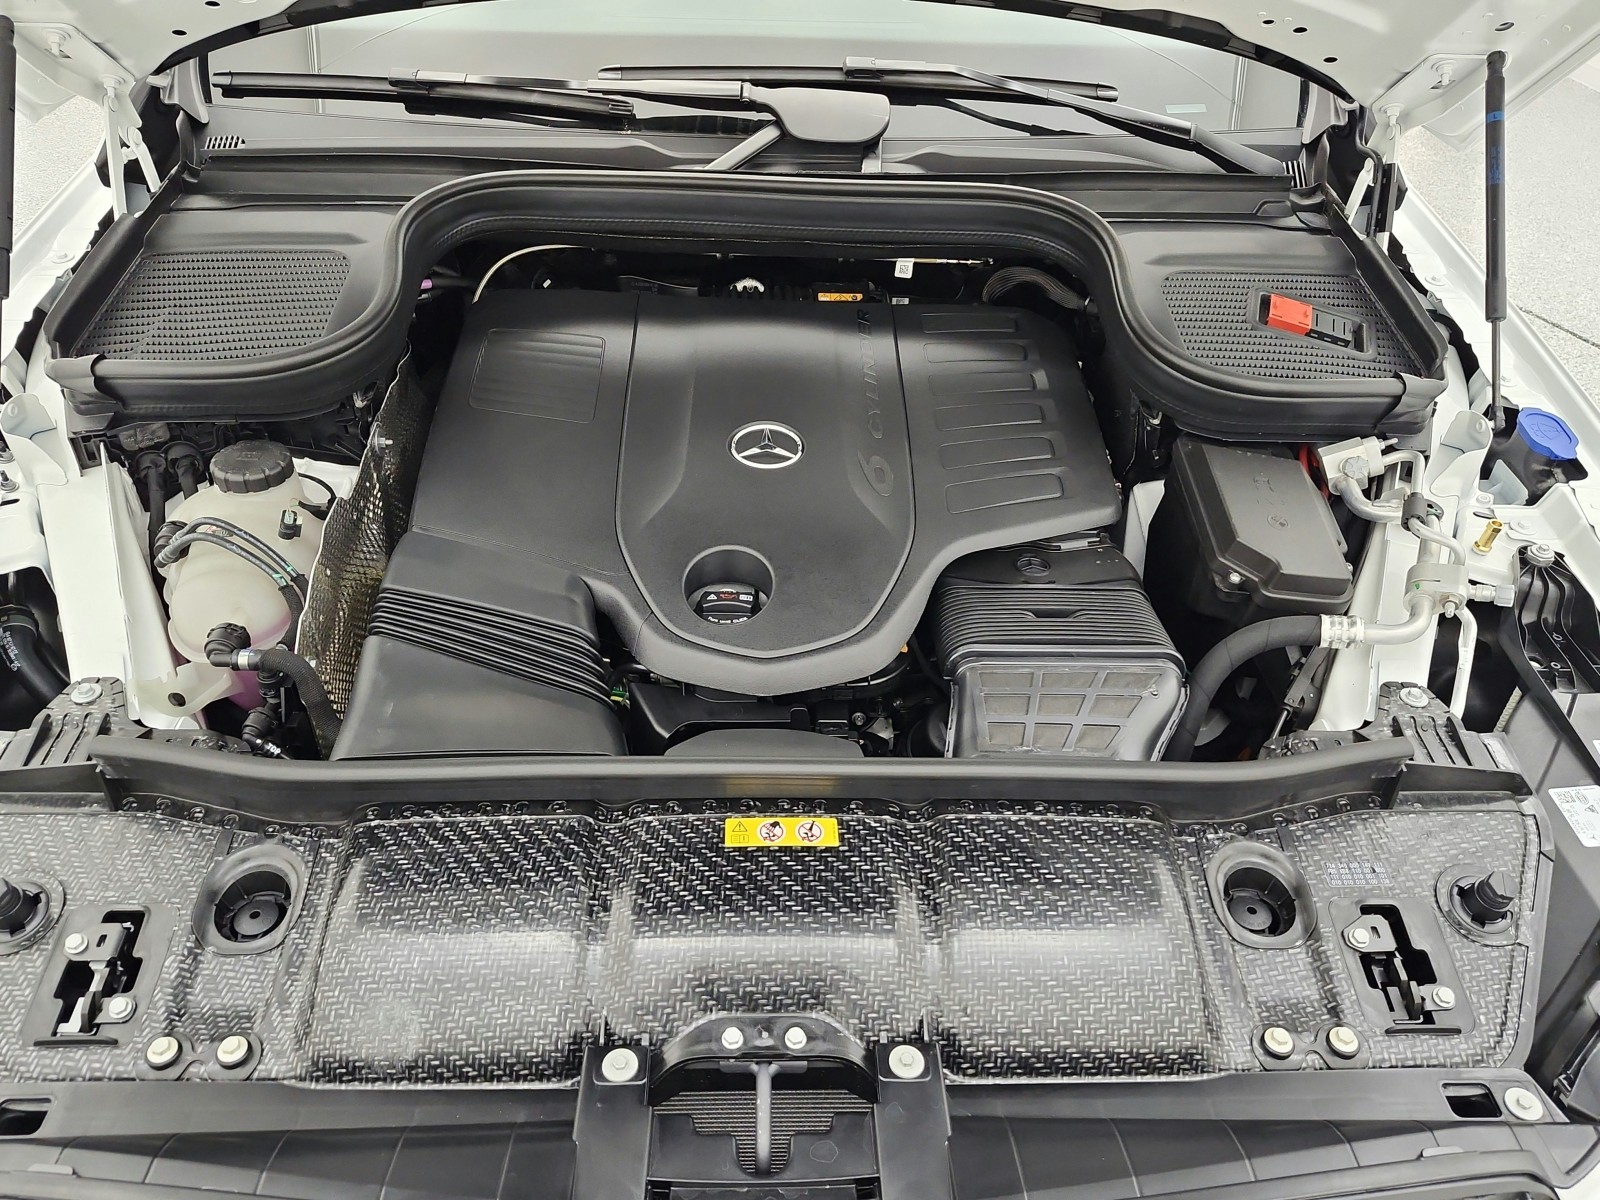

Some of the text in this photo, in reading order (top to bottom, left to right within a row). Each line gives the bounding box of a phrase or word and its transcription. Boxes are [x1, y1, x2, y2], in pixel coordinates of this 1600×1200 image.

[857, 309, 894, 497] 6 CYLINDER
[266, 742, 281, 756] TOP
